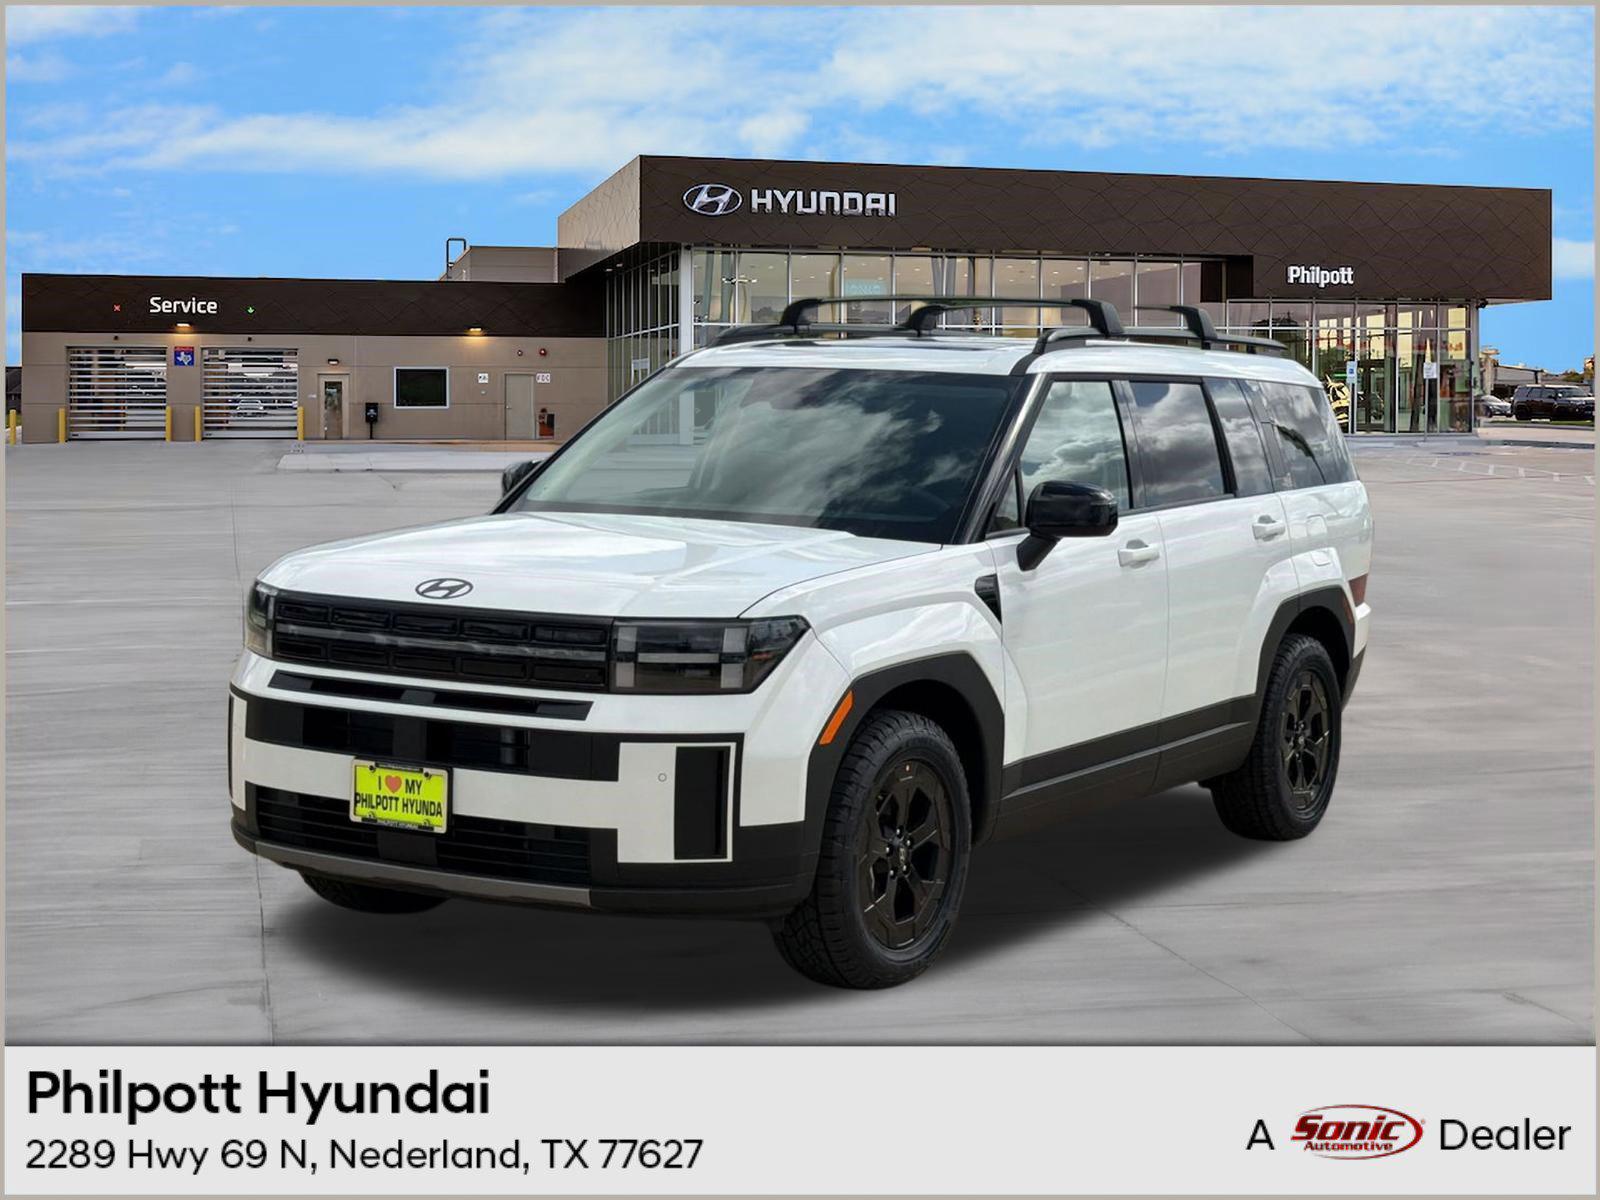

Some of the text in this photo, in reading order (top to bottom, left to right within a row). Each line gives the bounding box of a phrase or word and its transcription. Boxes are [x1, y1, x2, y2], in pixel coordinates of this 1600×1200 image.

[751, 188, 896, 216] HYUNDAI
[1287, 266, 1354, 288] Philpott
[149, 297, 218, 314] Service
[405, 779, 422, 795] MY
[354, 793, 400, 812] PHILPOTT
